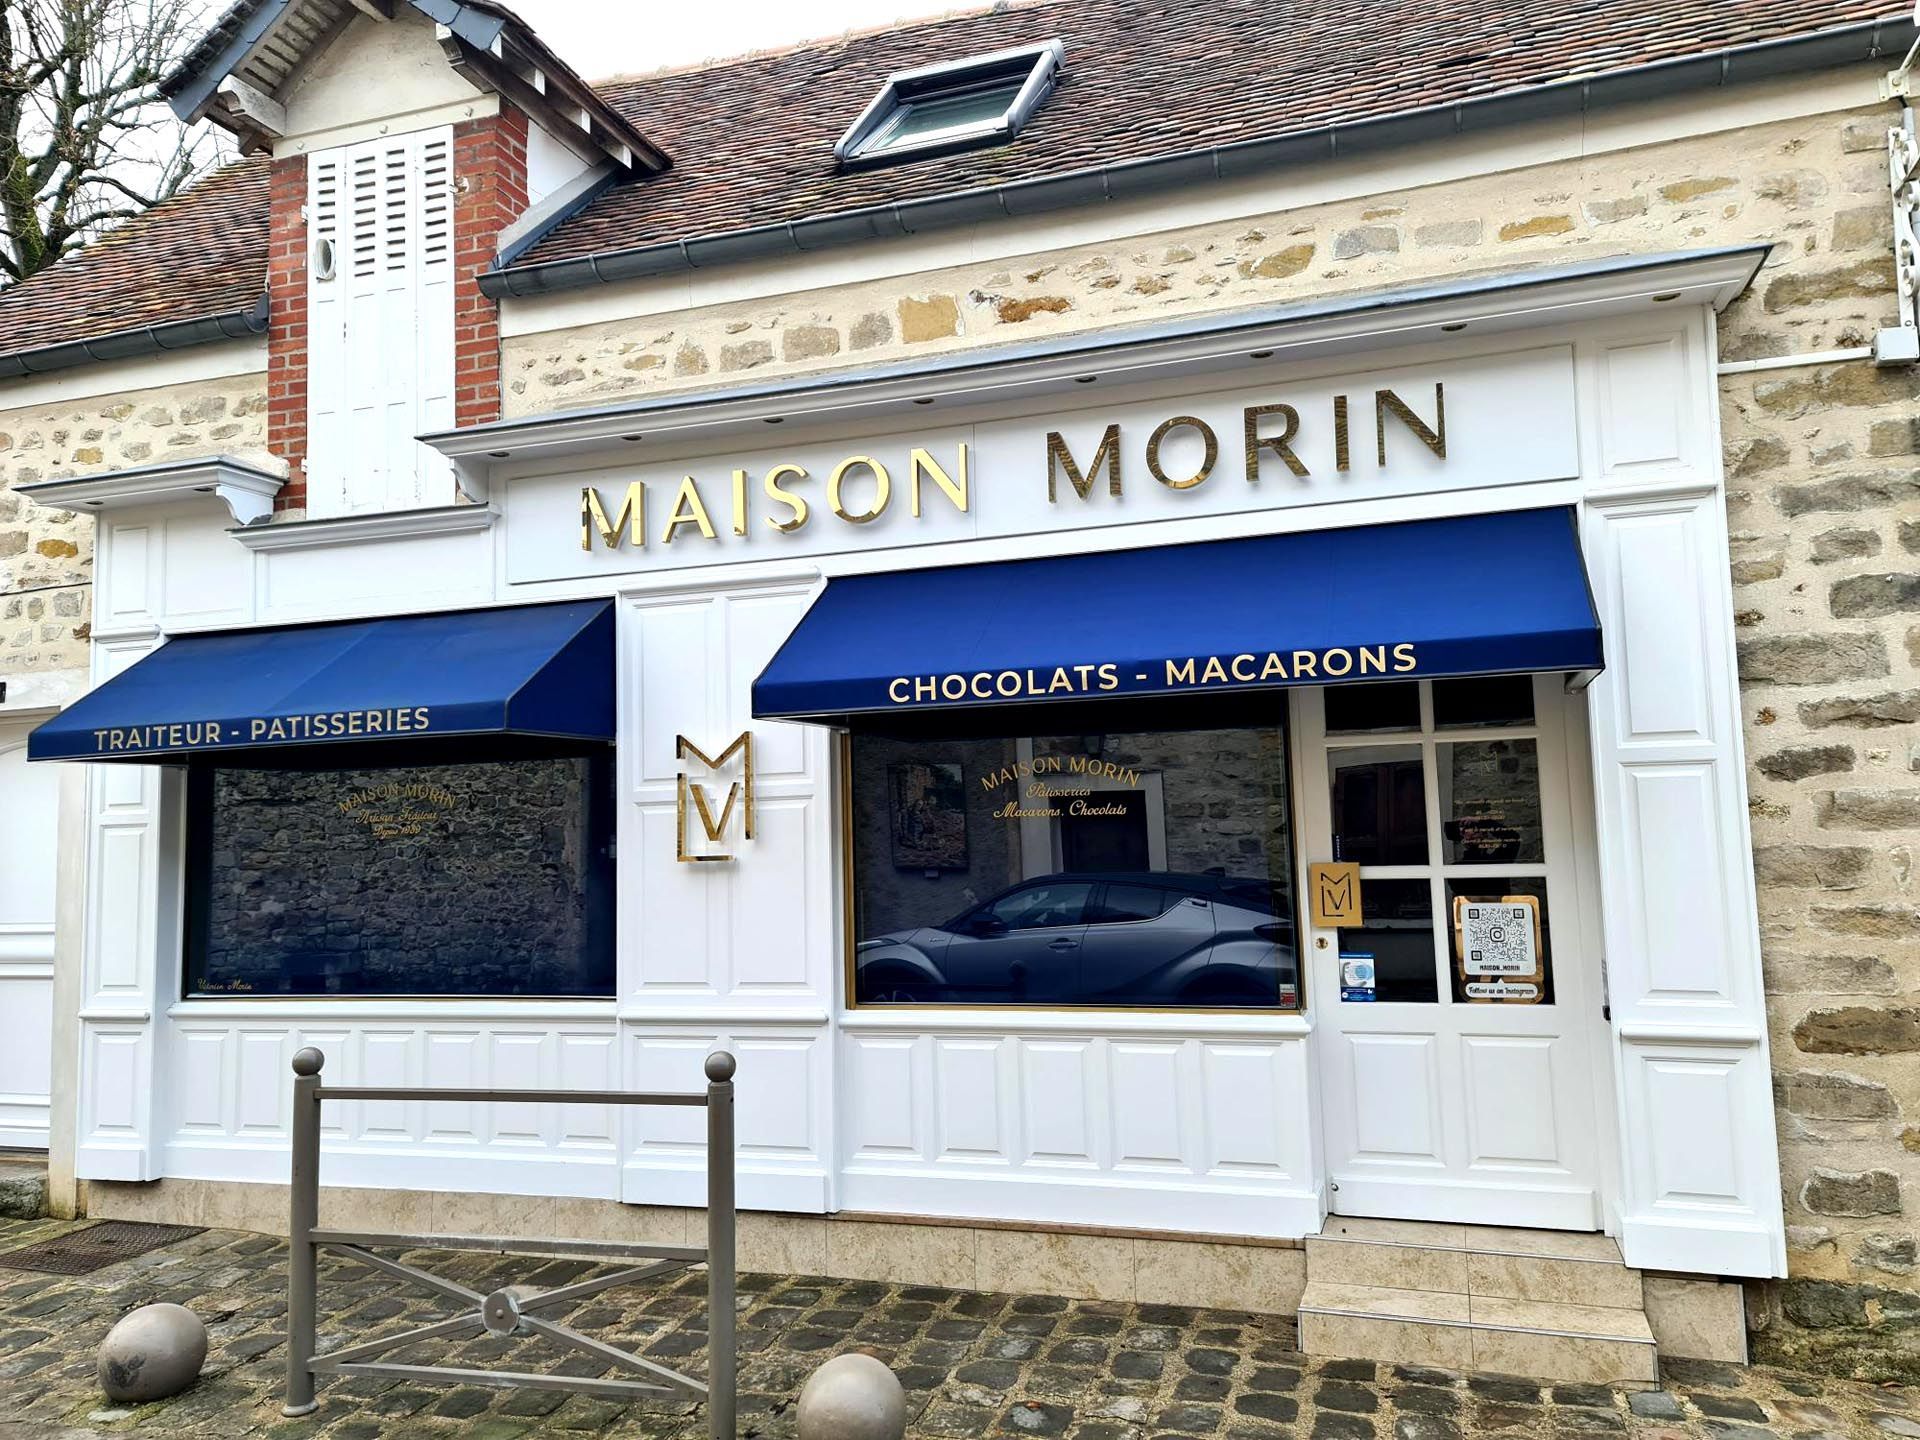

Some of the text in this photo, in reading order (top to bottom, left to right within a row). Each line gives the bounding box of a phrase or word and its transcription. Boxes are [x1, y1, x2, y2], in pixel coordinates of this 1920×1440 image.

[581, 383, 1446, 551] MAISON MORIN
[889, 664, 1118, 702] CHOCOLATS
[1165, 643, 1417, 686] MACARONS
[94, 723, 220, 750] TRAITEUR
[250, 706, 431, 741] PATISSERIES
[981, 756, 1140, 792] MAISON MORIN
[338, 783, 455, 813] MAISON MORIN
[1069, 800, 1127, 817] Chocolats
[1469, 986, 1487, 994] Follow
[1505, 986, 1534, 997] Instagram
